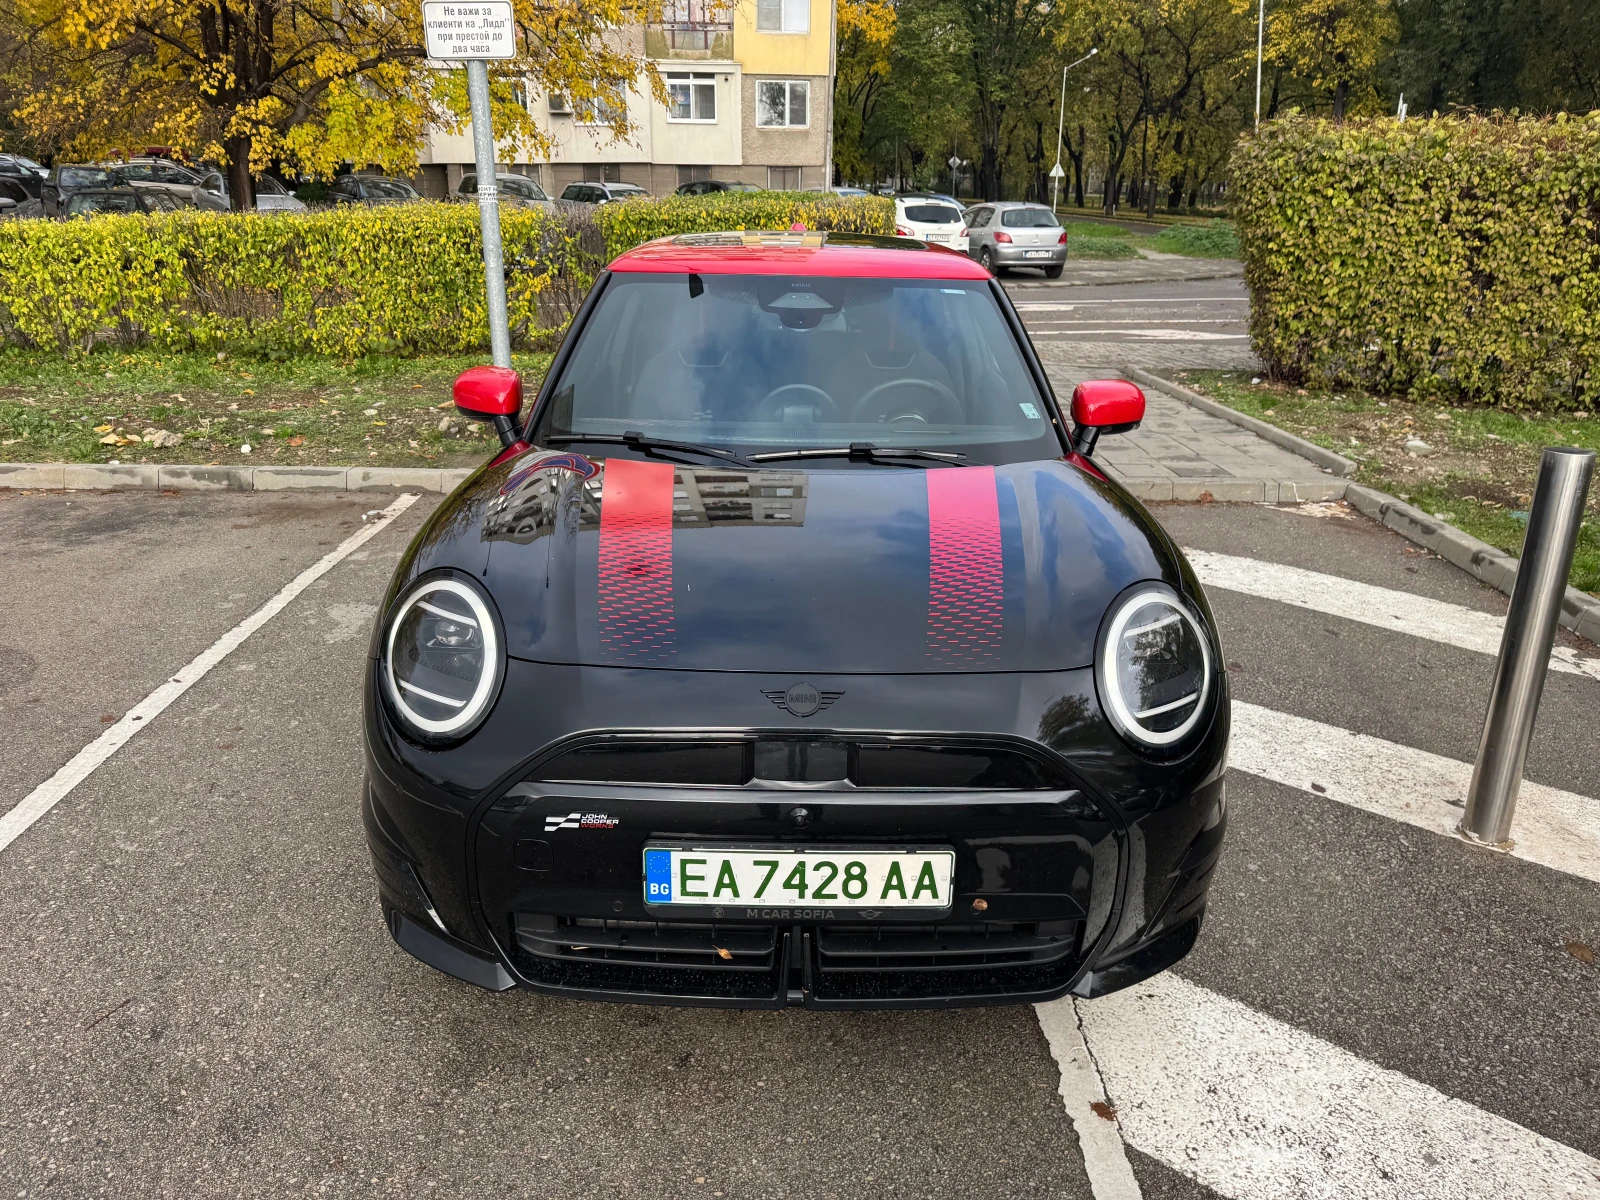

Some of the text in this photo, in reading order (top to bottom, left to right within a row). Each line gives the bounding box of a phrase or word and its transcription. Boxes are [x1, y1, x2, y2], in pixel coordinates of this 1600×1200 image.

[443, 6, 492, 16] Не важи за
[427, 20, 463, 29] клиенти
[465, 20, 476, 28] на
[437, 31, 503, 42] при престой до
[452, 45, 490, 55] два часа
[789, 694, 816, 703] MINI
[649, 858, 939, 900] BG EA 7428 AA
[746, 908, 835, 919] M CAR SOFIA
